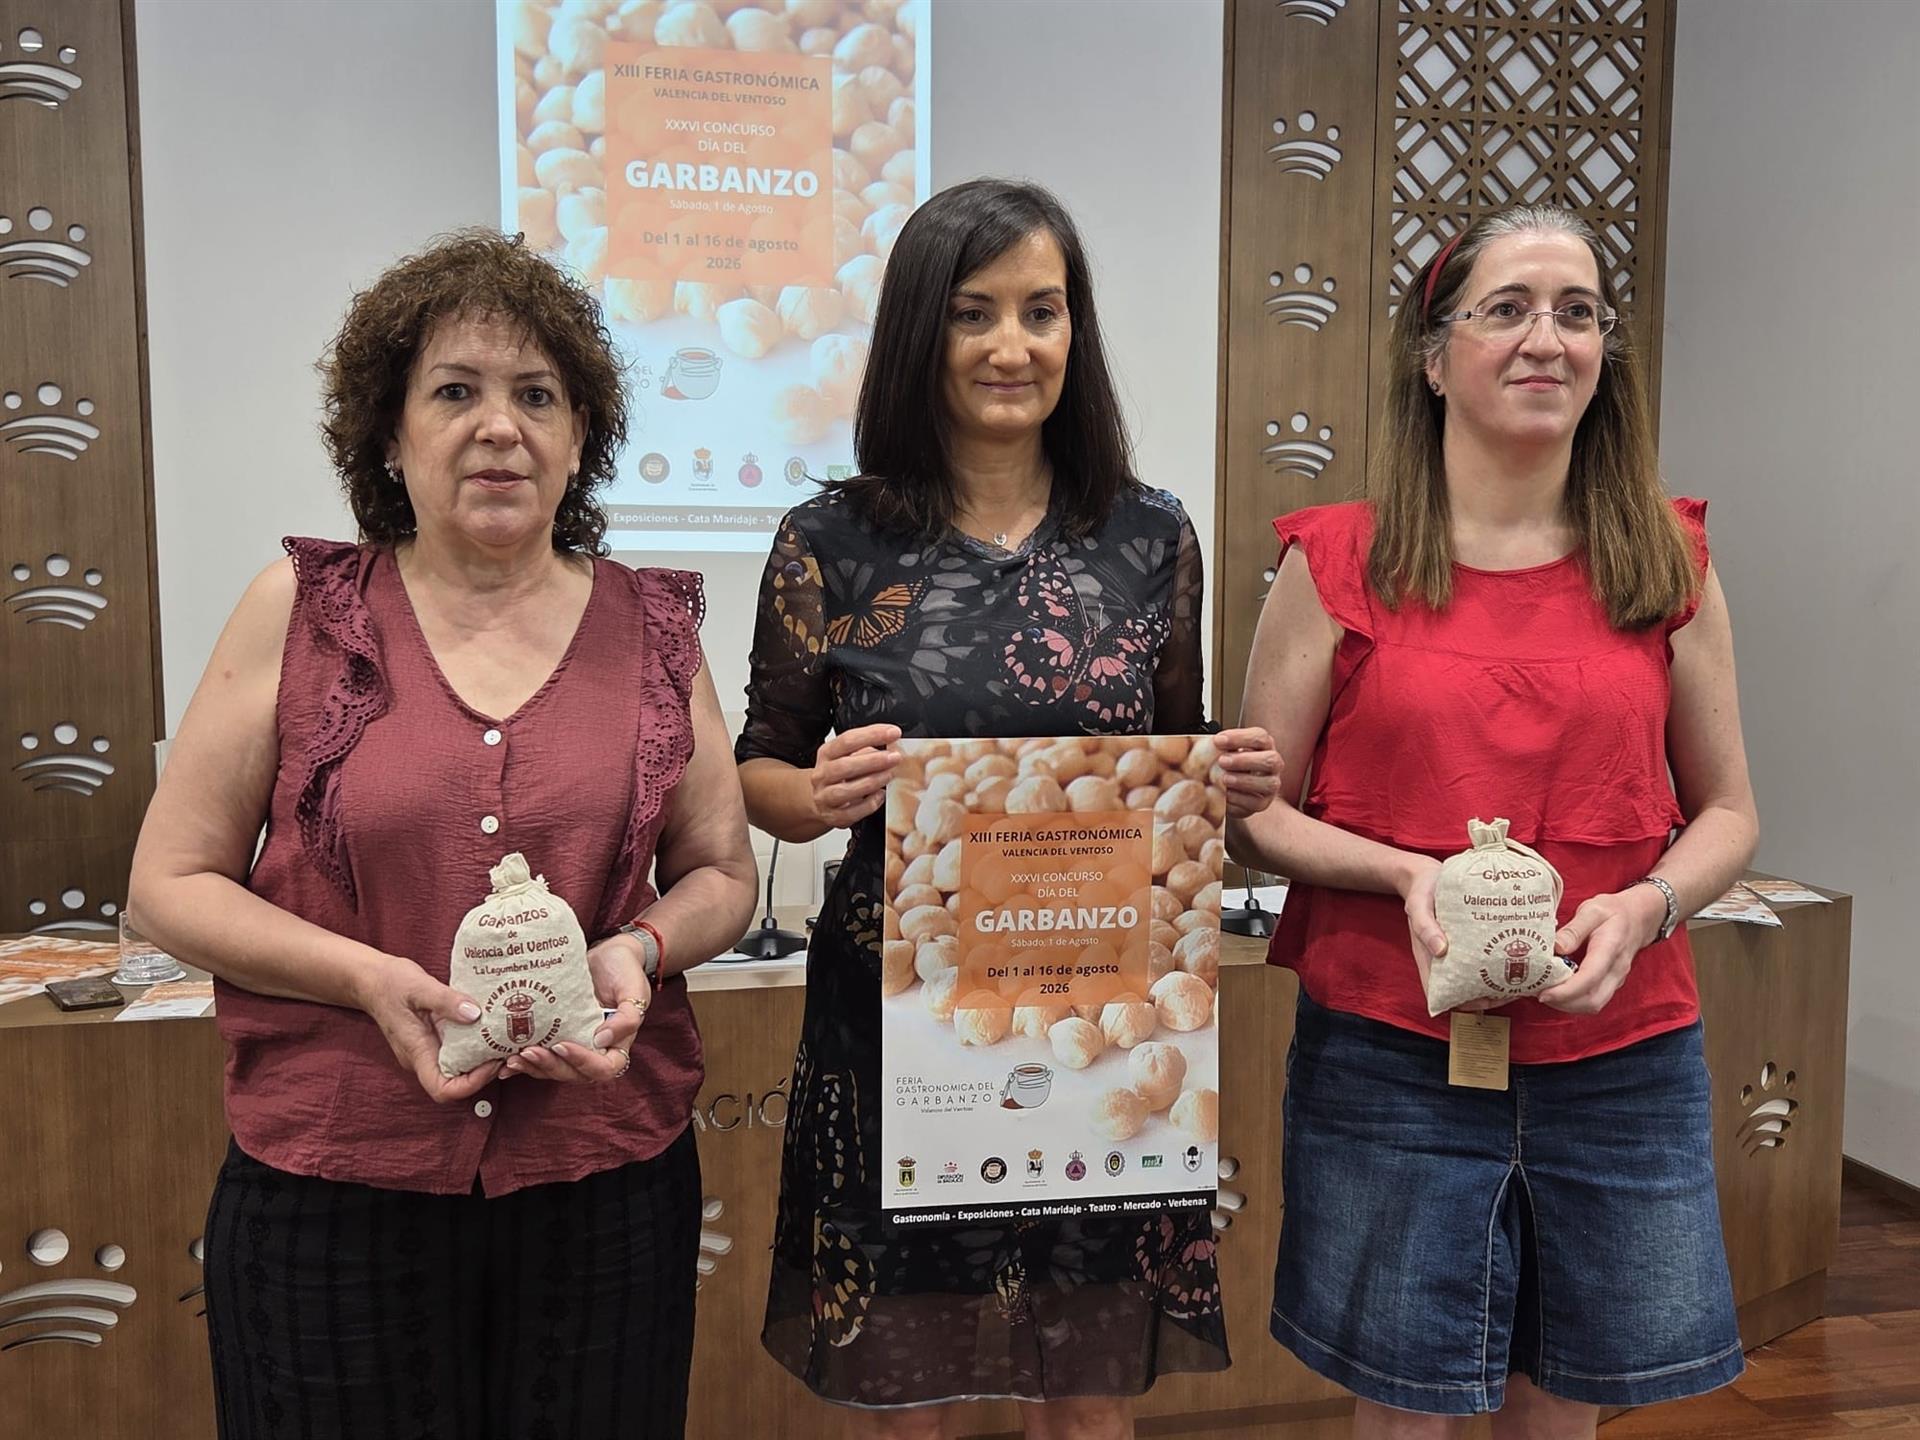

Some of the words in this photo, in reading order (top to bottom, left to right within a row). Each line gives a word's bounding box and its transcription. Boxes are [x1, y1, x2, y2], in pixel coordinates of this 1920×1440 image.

[614, 64, 640, 79] XIII
[644, 66, 688, 81] FERIA
[693, 69, 819, 91] GASTRONÓMICA
[653, 88, 705, 101] VALENCIA
[707, 91, 731, 103] DEL
[734, 93, 786, 105] VENTOSO
[666, 119, 700, 133] XXXVI
[703, 121, 775, 137] CONCURSO
[698, 139, 720, 153] DÍA
[723, 140, 747, 154] DEL
[625, 160, 819, 197] GARBANZO
[670, 199, 710, 214] Sábado,
[714, 202, 719, 212] 1
[723, 202, 735, 213] de
[738, 203, 773, 216] Agosto
[644, 231, 668, 246] Del
[674, 234, 679, 245] 1
[686, 233, 700, 246] al
[704, 235, 720, 247] 16
[724, 234, 744, 249] de
[748, 239, 798, 253] agosto
[706, 256, 741, 270] 2026
[614, 512, 678, 525] Exposiciones
[688, 514, 711, 525] Cata
[714, 514, 758, 527] Maridaje
[970, 831, 992, 843] XIII
[996, 830, 1032, 843] FERIA
[1036, 827, 1143, 841] GASTRONÓMICA
[1002, 848, 1048, 856] VALENCIA
[1050, 847, 1068, 855] DEL
[1070, 846, 1113, 855] VENTOSO
[1010, 873, 1040, 883] XXXVI
[1043, 871, 1103, 882] CONCURSO
[1038, 888, 1056, 897] DÍA
[1059, 887, 1078, 897] DEL
[1464, 895, 1507, 905] Valencia
[1511, 895, 1525, 905] del
[976, 906, 1138, 933] GARBANZO
[1487, 913, 1527, 922] Legumbre
[508, 930, 517, 938] de
[1050, 937, 1053, 945] 1
[1056, 937, 1067, 946] de
[1069, 936, 1099, 947] Agosto
[1484, 928, 1547, 955] AYUNTAMIENTO
[464, 946, 503, 958] Valencia
[507, 943, 524, 955] del
[527, 936, 569, 952] Ventoso
[486, 963, 528, 976] Legumbre
[988, 966, 1009, 978] Del
[1014, 967, 1019, 976] 1
[1023, 965, 1034, 976] al
[1039, 965, 1053, 975] 16
[1056, 964, 1072, 975] de
[1076, 964, 1119, 977] agosto
[1480, 969, 1504, 992] VALENCIA
[1527, 965, 1552, 989] VENTOSO
[1040, 983, 1069, 994] 2026
[486, 980, 556, 1013] AYUNTAMIENTO
[481, 1027, 512, 1053] VALENCIA
[897, 1077, 923, 1085] FERIA
[897, 1083, 974, 1094] GASTRONOMICA
[978, 1082, 994, 1090] DEL
[892, 1211, 950, 1224] Gastronomía
[958, 1209, 1013, 1220] Exposiciones
[1021, 1208, 1040, 1216] Cata
[1043, 1204, 1082, 1215] Maridaje
[1089, 1203, 1116, 1212] Teatro
[1124, 1200, 1161, 1210] Mercado
[1168, 1198, 1207, 1207] Verbenas
